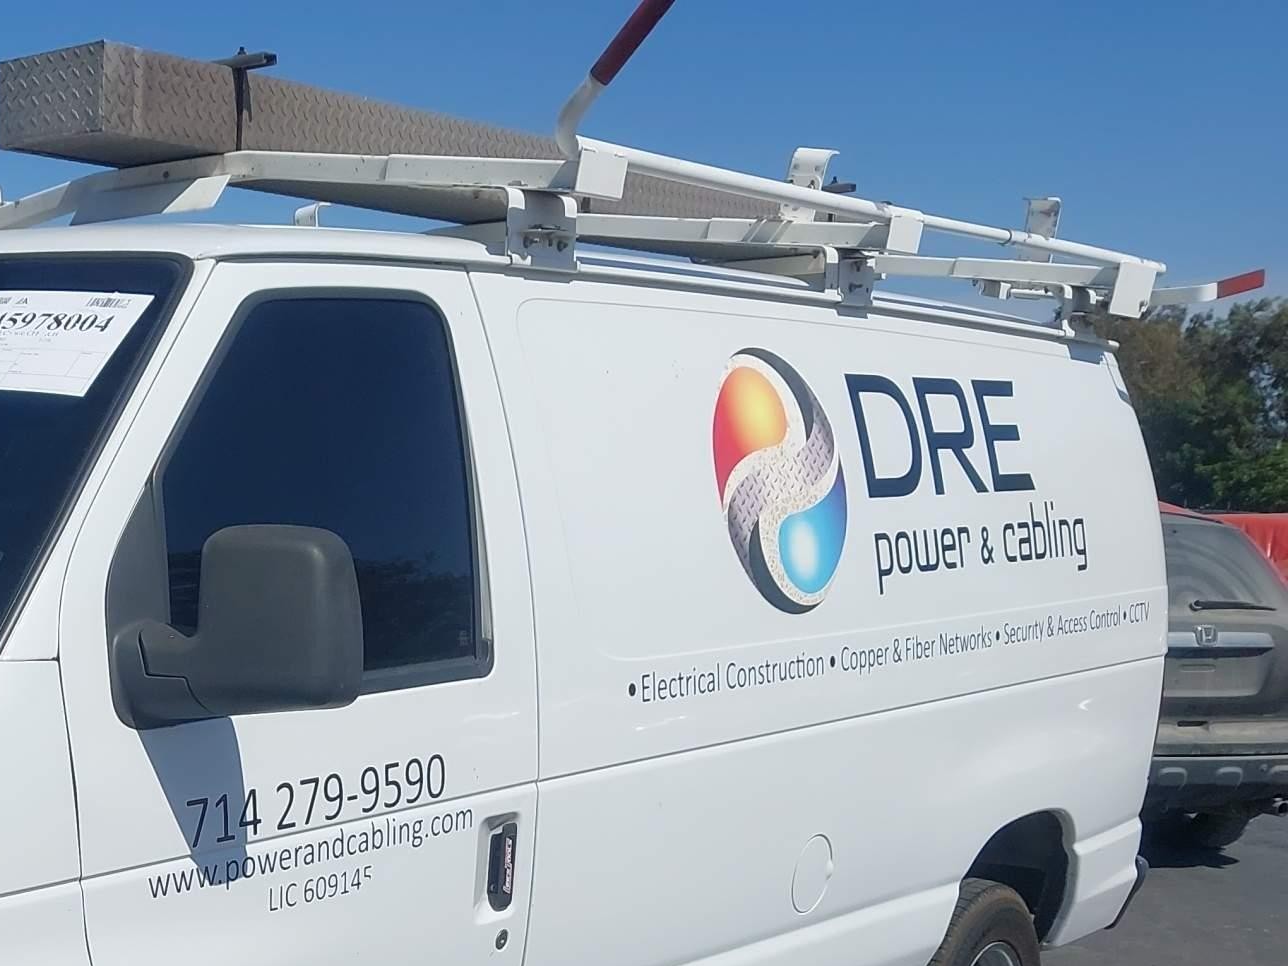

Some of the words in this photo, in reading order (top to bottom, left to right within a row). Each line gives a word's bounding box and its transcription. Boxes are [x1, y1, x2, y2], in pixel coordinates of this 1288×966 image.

[844, 373, 1036, 498] DRE
[874, 525, 971, 595] power
[980, 526, 994, 565] &
[1002, 500, 1088, 572] cabling
[641, 662, 720, 702] Electrical
[726, 652, 824, 690] Construction
[841, 645, 889, 675] Copper
[892, 638, 902, 663] &
[905, 634, 936, 661] Fiber
[939, 624, 992, 656] Networks
[1003, 619, 1045, 646] Security
[1046, 615, 1054, 638] &
[1057, 614, 1088, 636] Access
[1089, 604, 1121, 631] Control
[1129, 601, 1150, 624] CCTV
[187, 788, 262, 849] 714
[276, 753, 446, 831] 279-9590
[149, 807, 473, 900] www.powerandcabling.com
[269, 882, 298, 912] LIC
